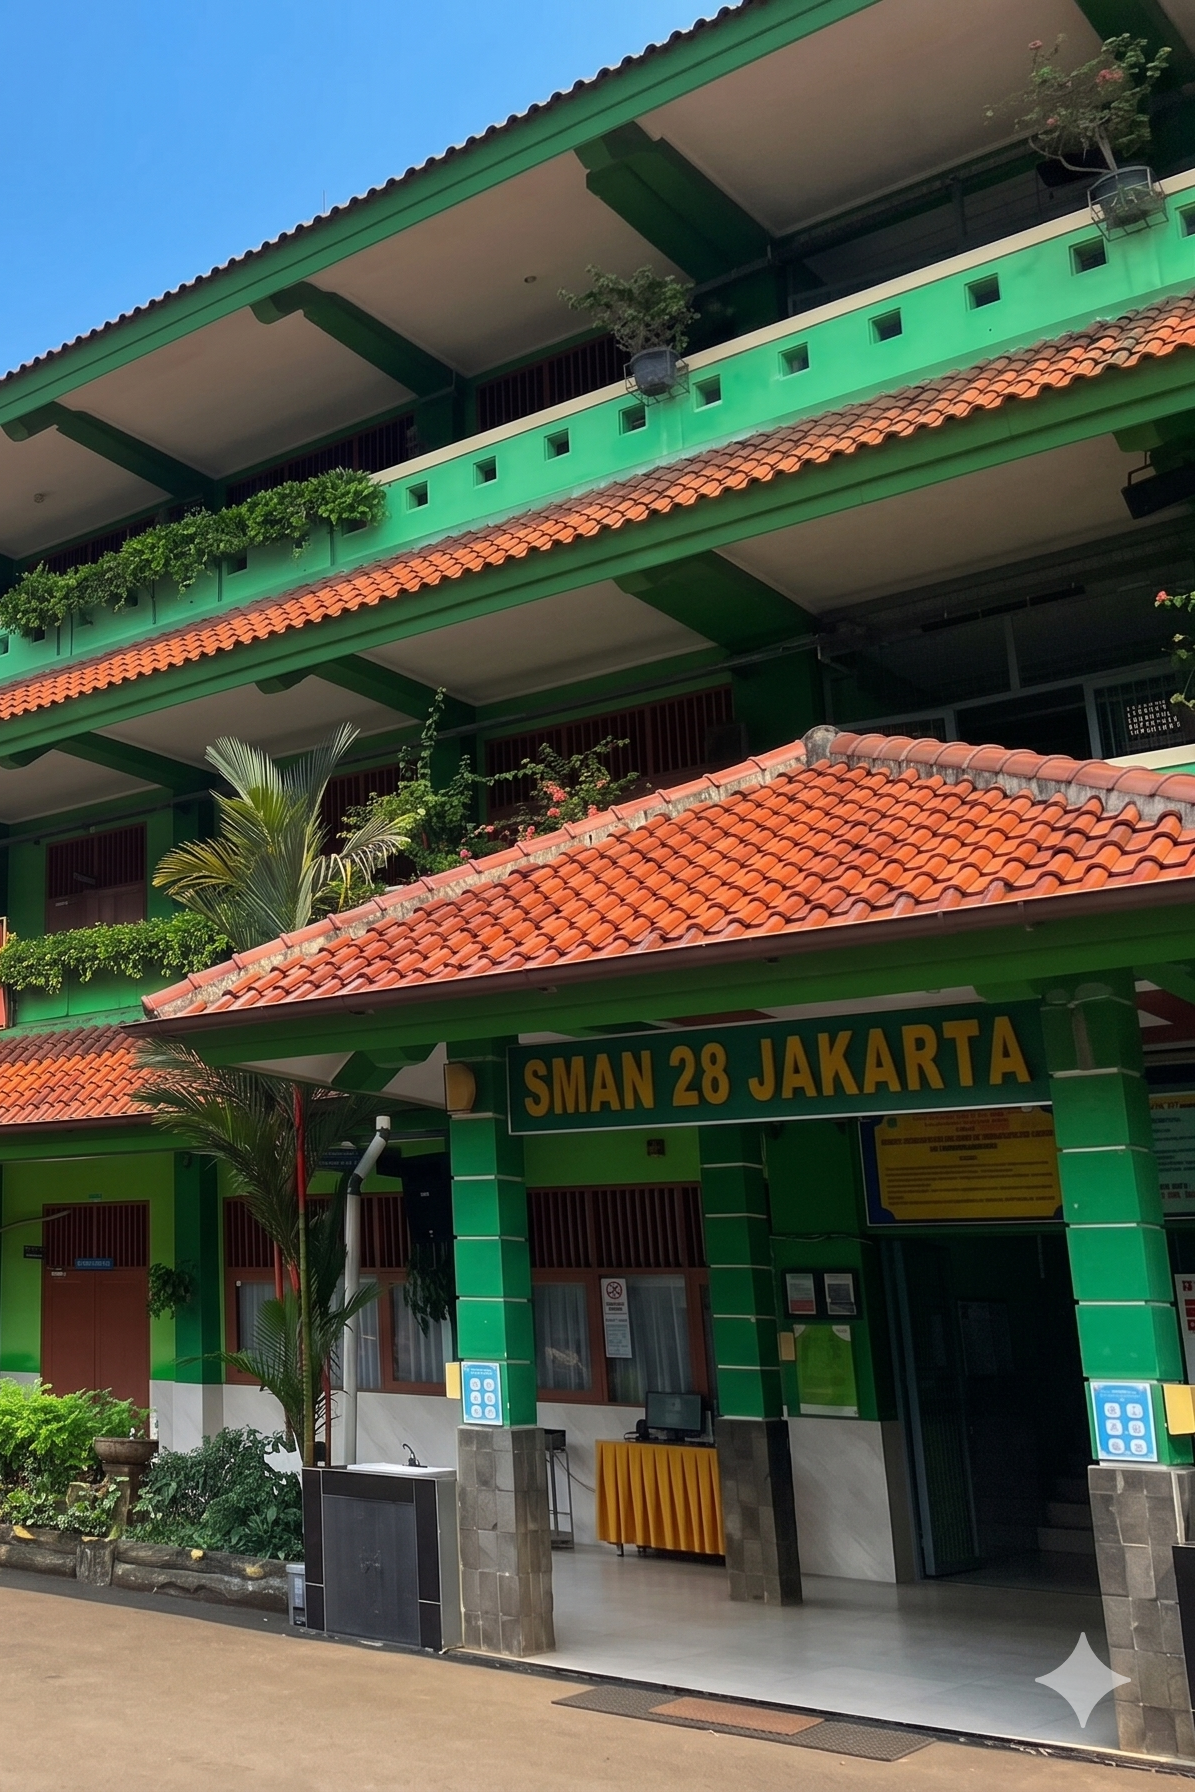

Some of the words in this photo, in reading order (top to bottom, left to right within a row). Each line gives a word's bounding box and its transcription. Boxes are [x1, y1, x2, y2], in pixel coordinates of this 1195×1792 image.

[523, 1051, 655, 1117] SMAN
[670, 1042, 731, 1106] 28
[748, 1016, 1032, 1100] JAKARTA
